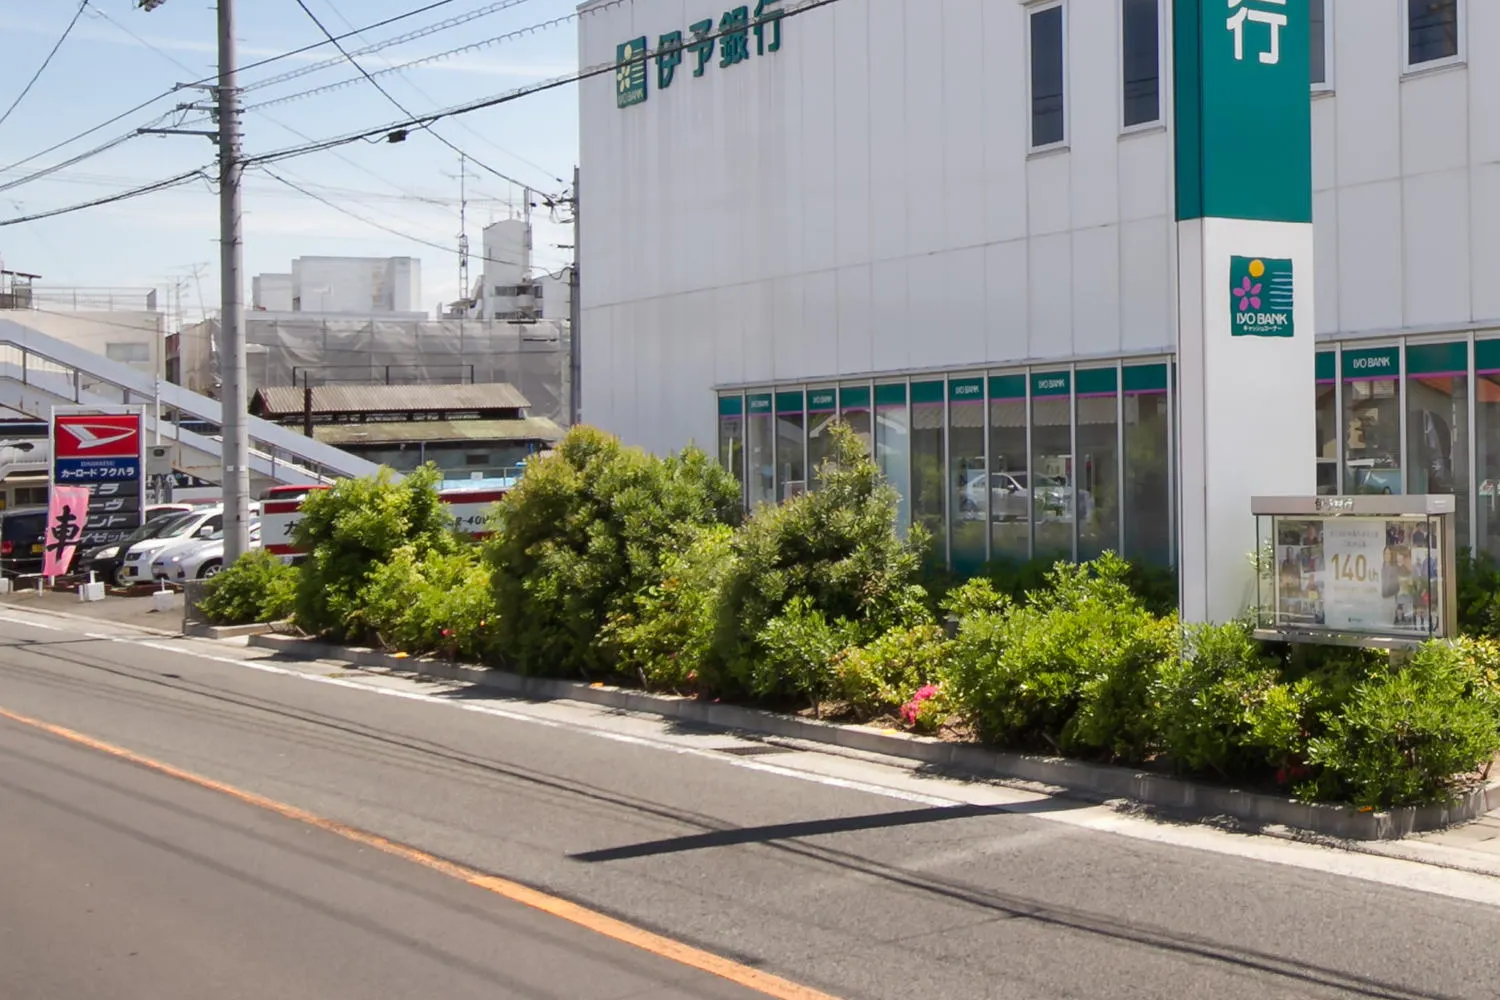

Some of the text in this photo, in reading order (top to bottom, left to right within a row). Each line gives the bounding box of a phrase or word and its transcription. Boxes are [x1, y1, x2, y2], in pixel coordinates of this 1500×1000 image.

[1236, 312, 1288, 325] IYO BANK
[1353, 356, 1391, 369] IYO BANK
[1049, 378, 1065, 389] BANK
[61, 467, 135, 478] カーロード フクハラ
[46, 505, 81, 562] 車
